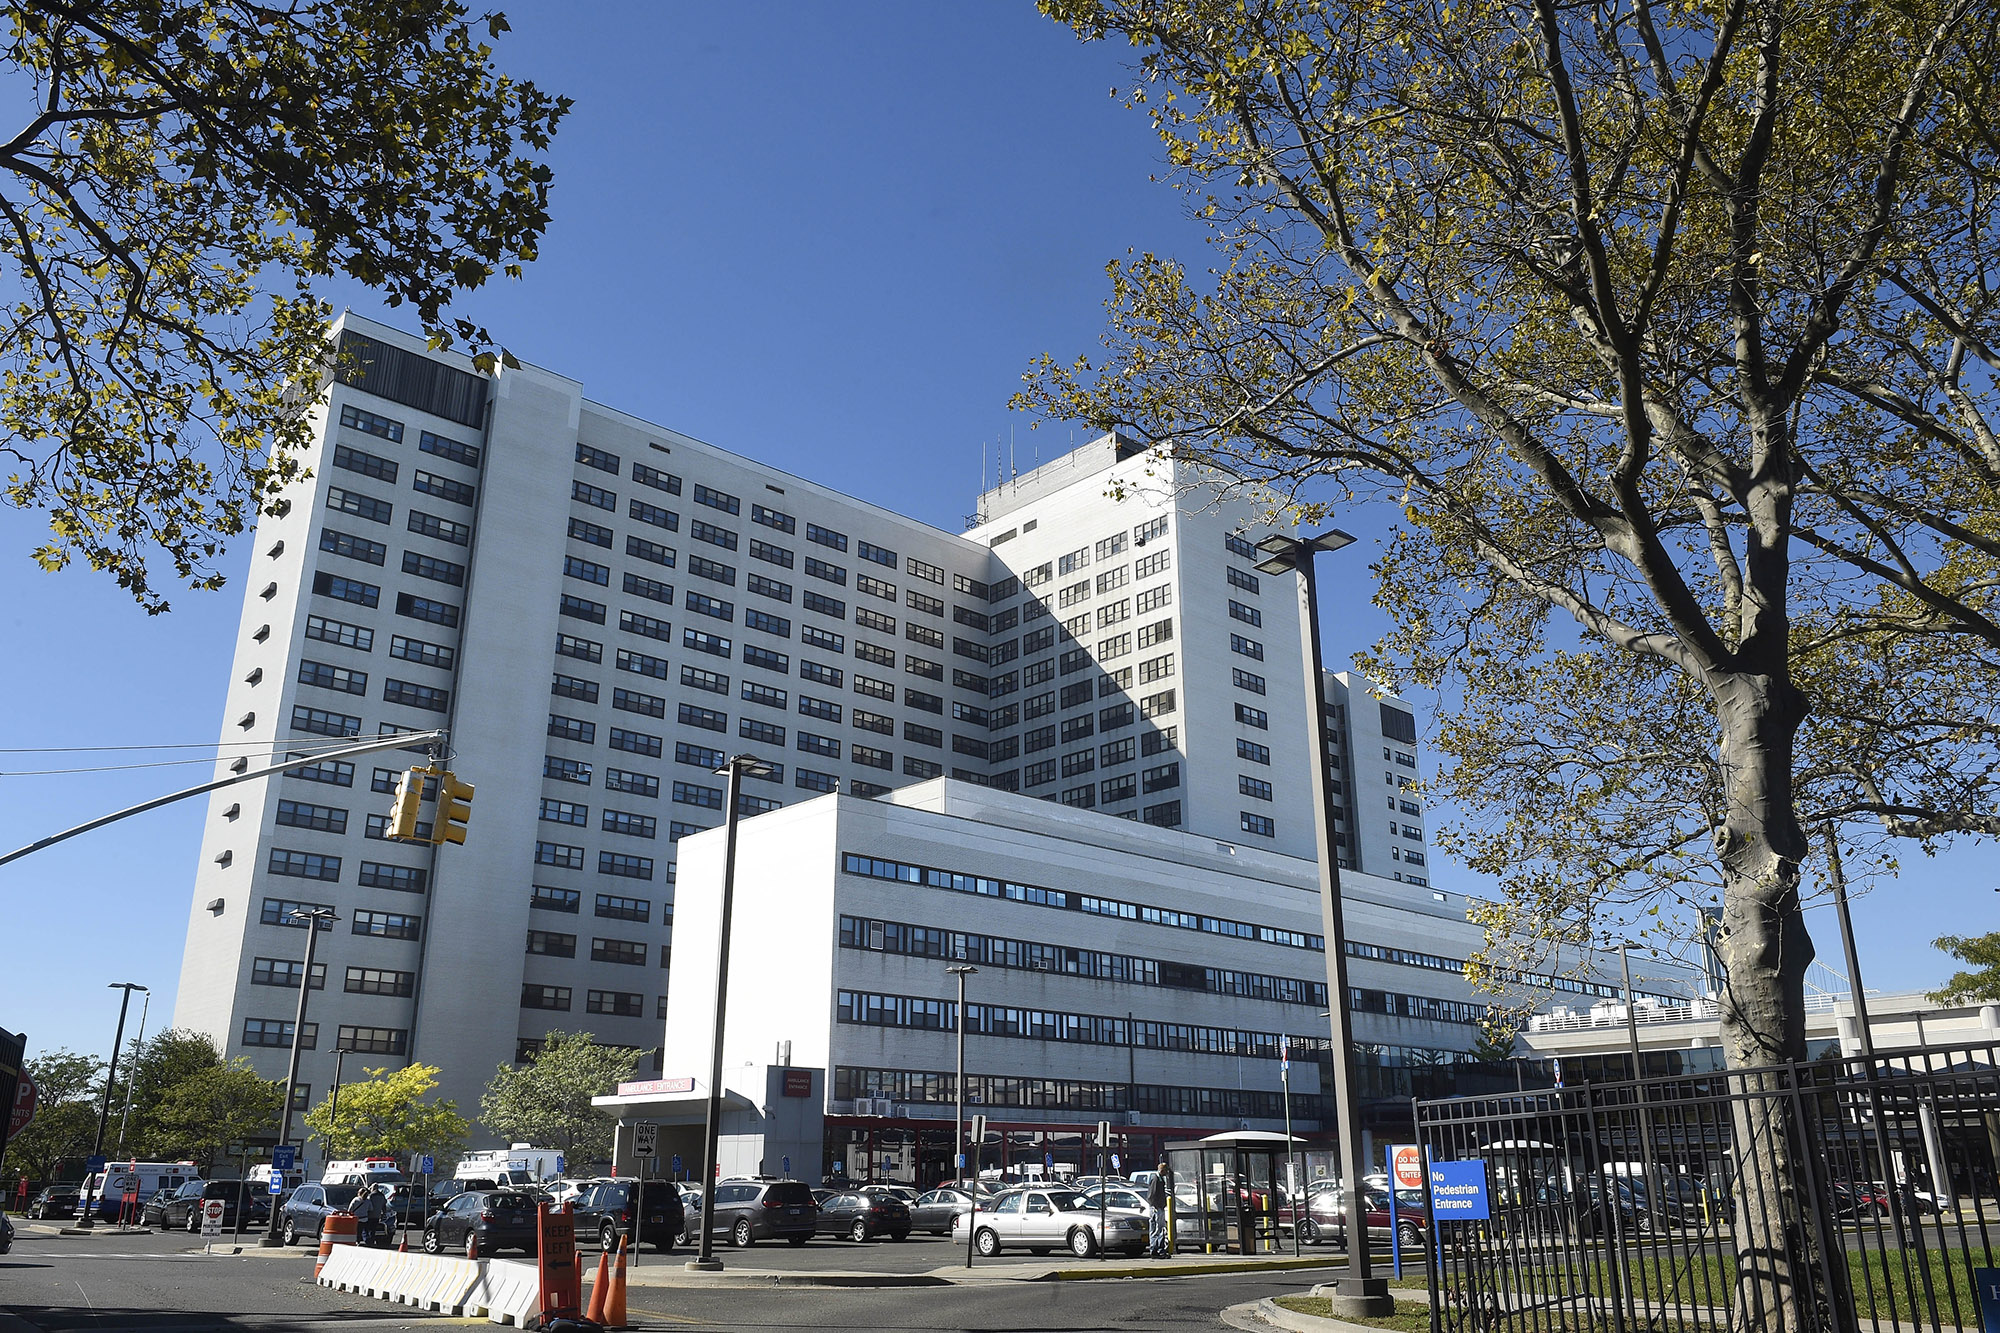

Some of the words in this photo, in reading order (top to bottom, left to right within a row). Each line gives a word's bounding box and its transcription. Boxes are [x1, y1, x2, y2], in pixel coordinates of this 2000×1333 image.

[624, 1083, 653, 1093] AMBULANCE
[656, 1080, 685, 1090] ENTRANCE
[638, 1126, 656, 1135] ONE
[637, 1135, 656, 1144] WAY
[1432, 1172, 1444, 1181] No
[1433, 1184, 1479, 1195] Pedestrian
[1435, 1199, 1473, 1209] Entrance
[544, 1225, 571, 1237] KEEP
[546, 1242, 571, 1254] LEFT
